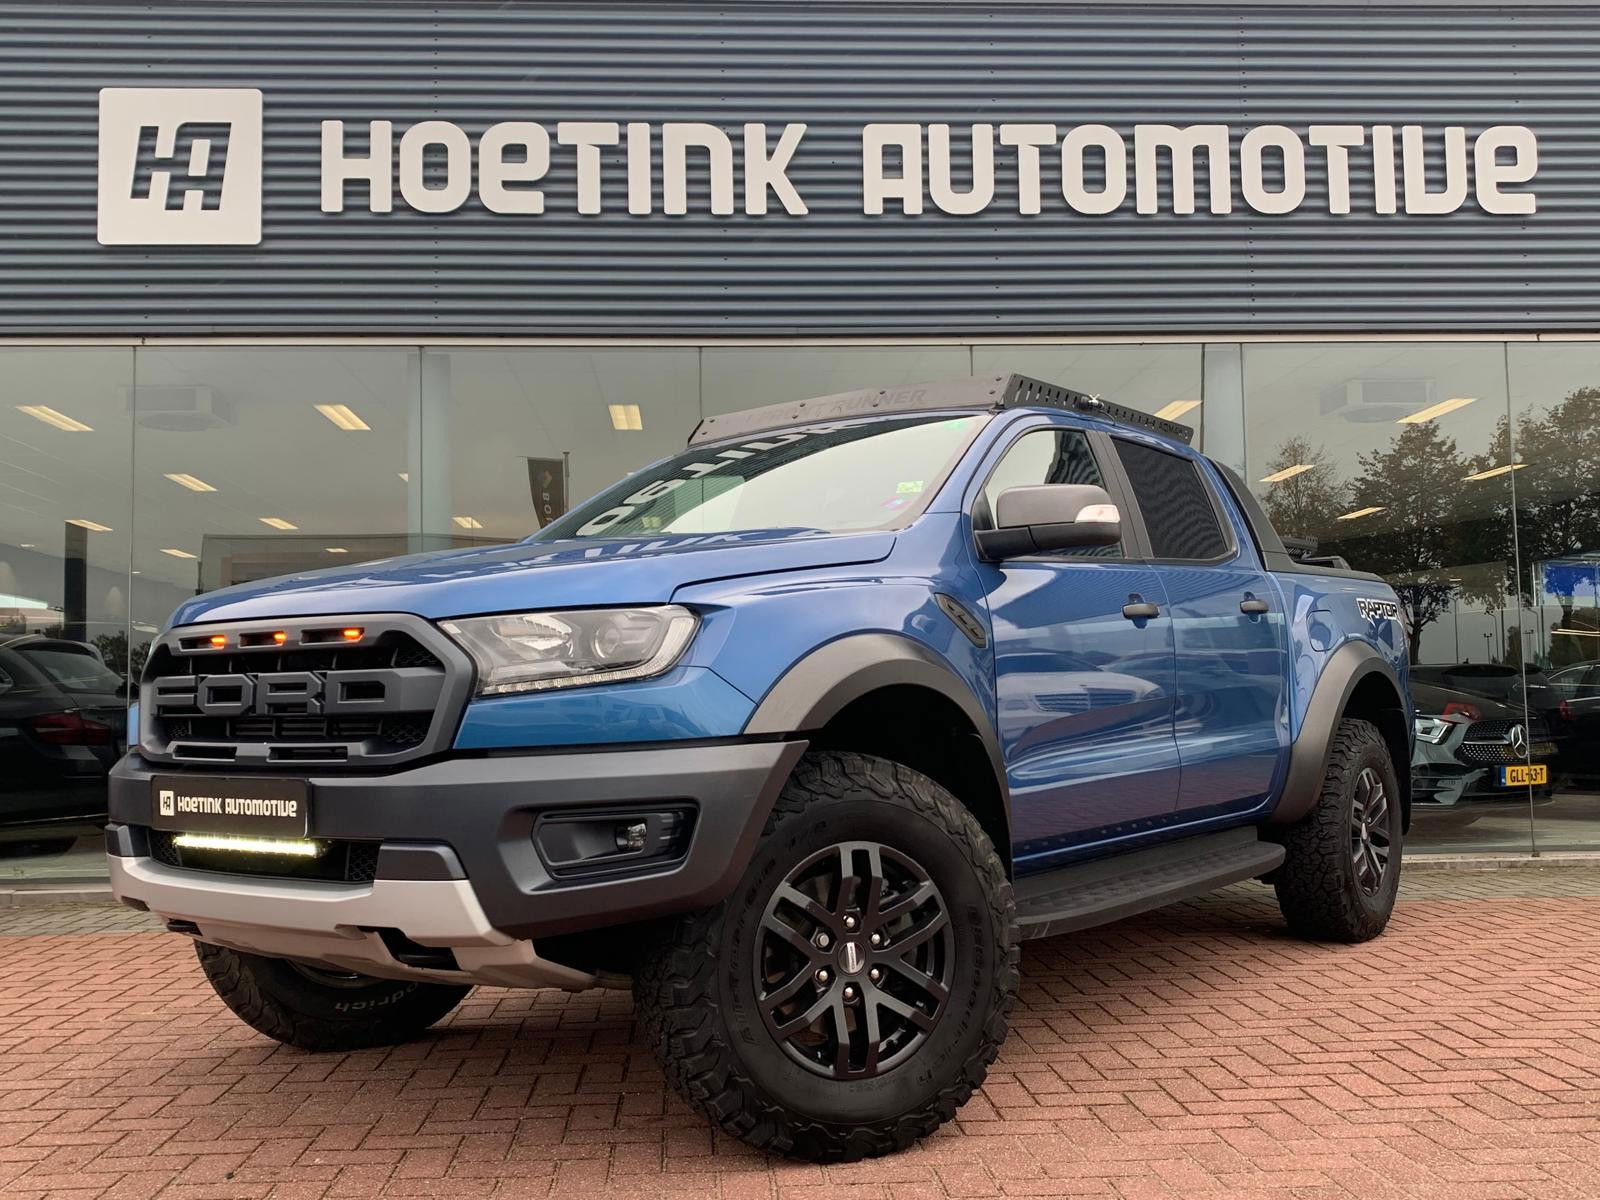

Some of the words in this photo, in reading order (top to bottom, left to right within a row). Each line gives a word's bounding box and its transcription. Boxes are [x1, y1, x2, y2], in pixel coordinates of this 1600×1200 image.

[321, 120, 809, 215] HOETINK
[862, 123, 1538, 216] AUTOMOTIVE
[1356, 597, 1401, 624] RAPTOR
[151, 671, 394, 718] FORD
[177, 795, 223, 814] HOETINK
[225, 798, 297, 817] AUTOMOTIVE
